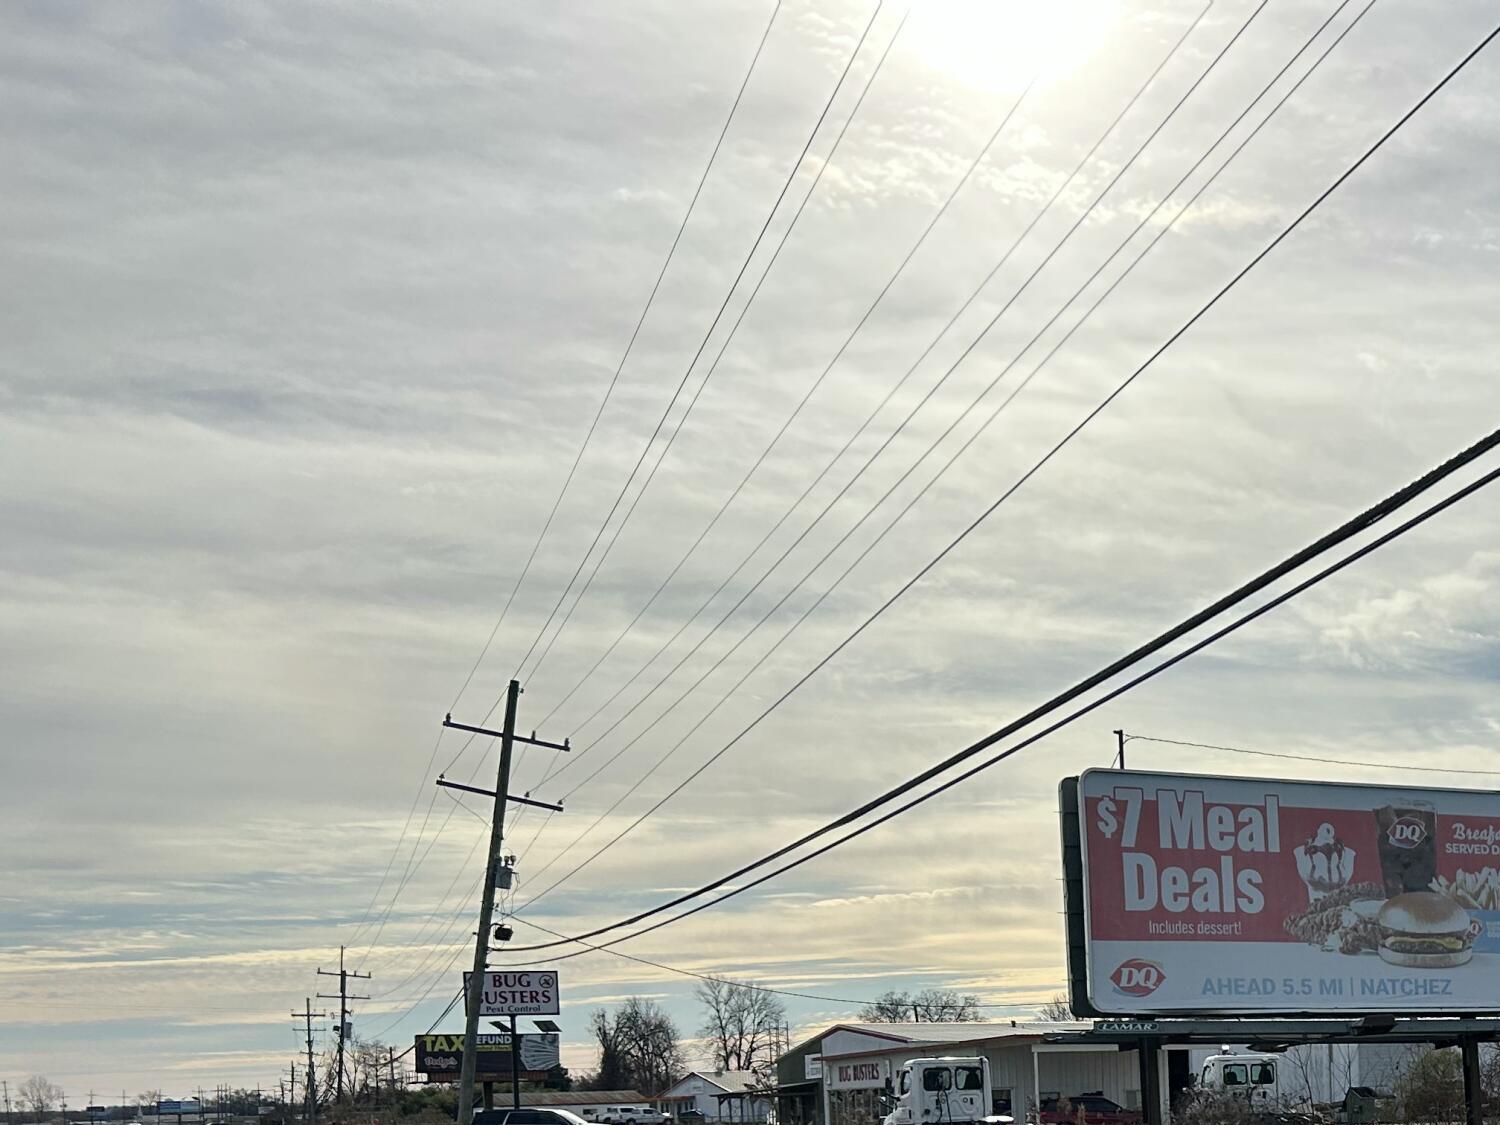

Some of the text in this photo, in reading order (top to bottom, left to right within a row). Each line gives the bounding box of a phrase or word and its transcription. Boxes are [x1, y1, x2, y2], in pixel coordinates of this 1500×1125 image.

[1097, 787, 1281, 853] $7 Meal
[1395, 823, 1422, 841] DQ
[1446, 843, 1489, 855] SERVED
[1122, 852, 1265, 914] Deals
[1149, 919, 1242, 935] Includes dessert!
[492, 973, 531, 988] BUG
[1119, 967, 1157, 990] DQ
[1201, 977, 1276, 996] AHEAD
[1282, 978, 1313, 996] 5.5
[1319, 978, 1343, 996] MI
[1360, 978, 1453, 996] NATCHEZ
[480, 989, 552, 1005] USTERS
[486, 1004, 541, 1013] Pest Control
[1102, 1023, 1153, 1031] LAMAR
[423, 1035, 465, 1052] TAX
[476, 1035, 512, 1045] EFUND
[838, 1065, 852, 1082] BUG
[853, 1063, 880, 1081] BUSTERS
